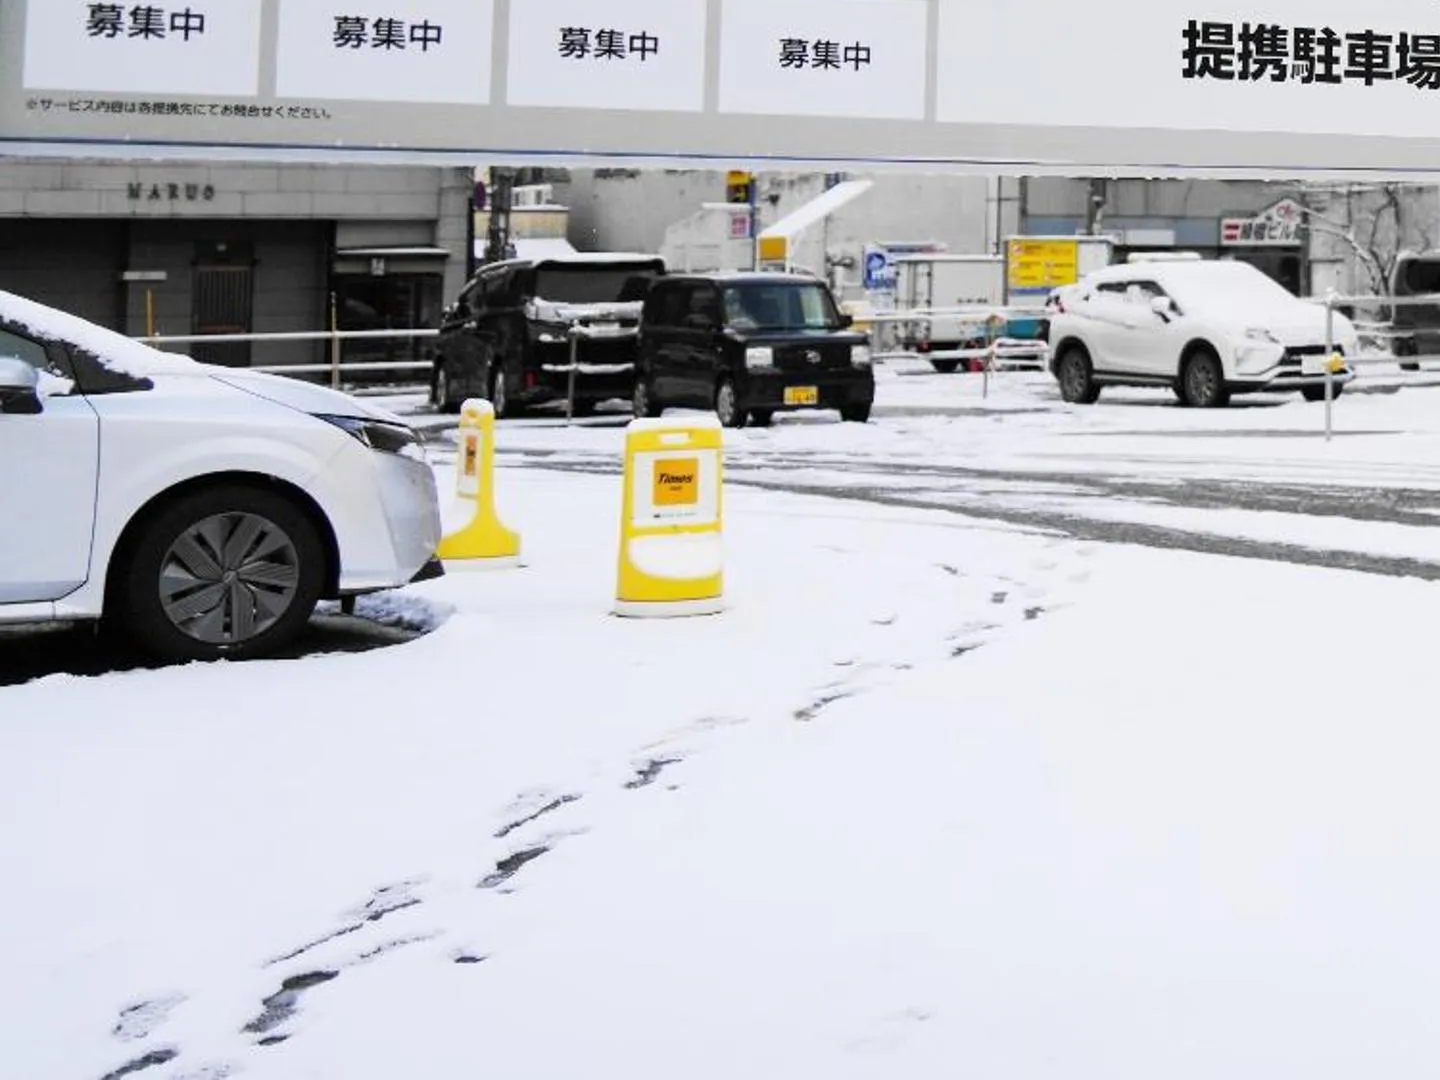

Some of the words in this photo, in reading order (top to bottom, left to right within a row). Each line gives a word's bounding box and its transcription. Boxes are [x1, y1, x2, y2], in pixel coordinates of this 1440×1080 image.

[86, 2, 205, 42] 募集中
[332, 15, 442, 52] 募集中
[558, 26, 660, 63] 募集中
[778, 38, 872, 72] 募集中
